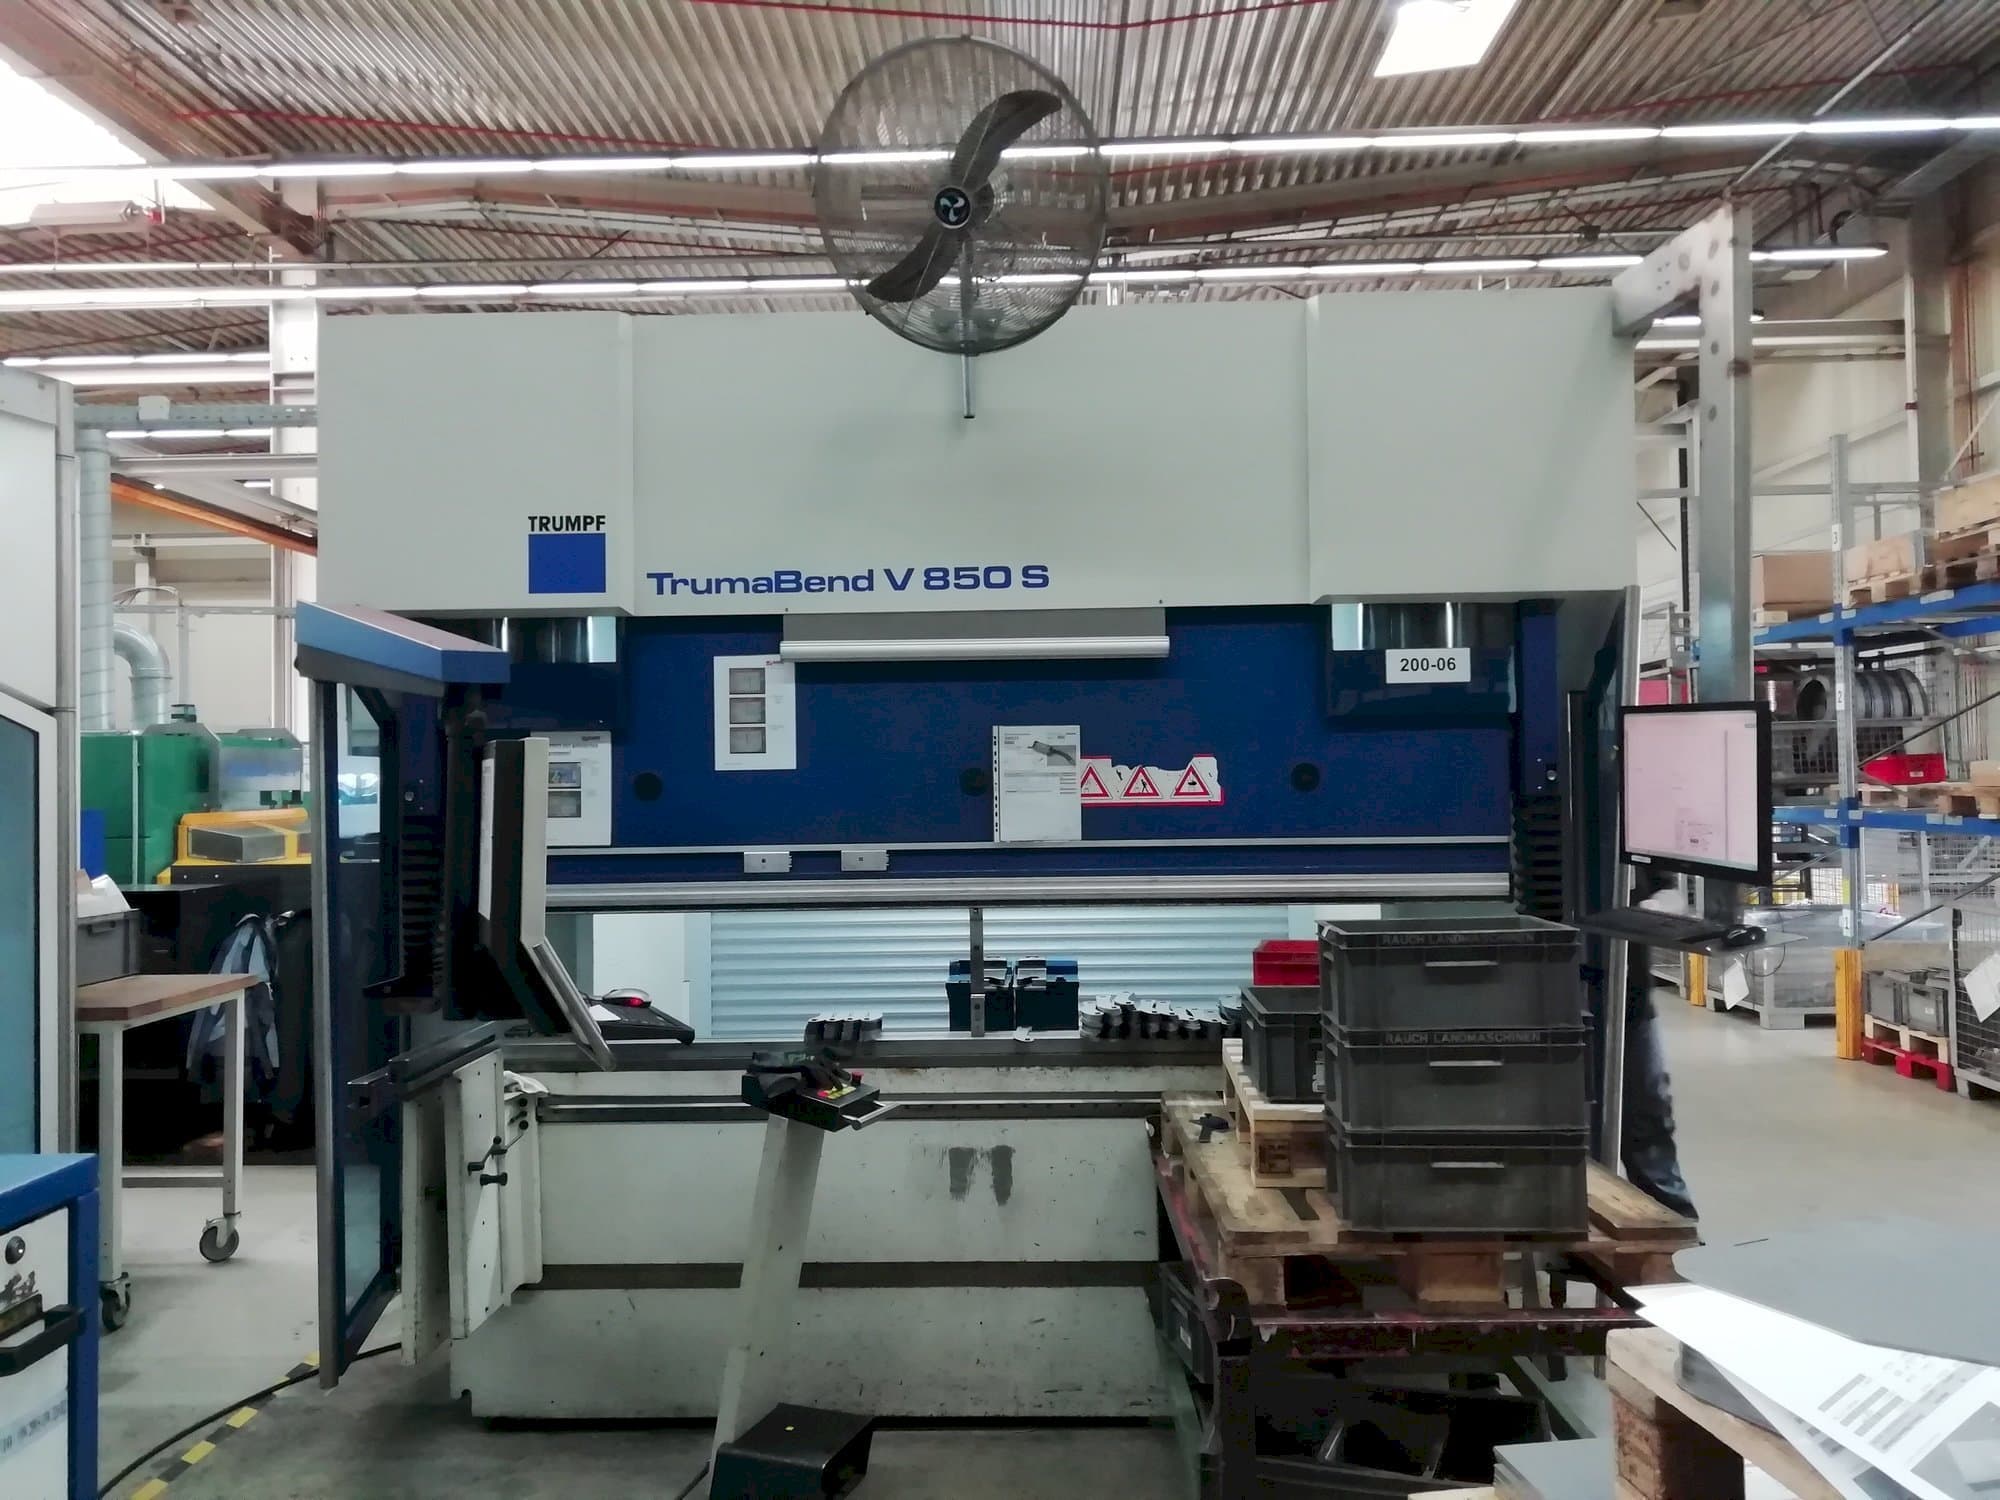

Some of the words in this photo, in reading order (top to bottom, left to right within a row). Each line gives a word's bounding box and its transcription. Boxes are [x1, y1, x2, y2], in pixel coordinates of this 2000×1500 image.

[527, 515, 606, 532] TRUMPF
[647, 569, 874, 595] TrumaBend
[884, 568, 914, 592] V
[922, 566, 1013, 591] 850
[1022, 565, 1049, 589] S
[1400, 657, 1456, 672] 200-06
[1382, 935, 1425, 946] RAUCH
[1385, 1032, 1428, 1044] RAUCH
